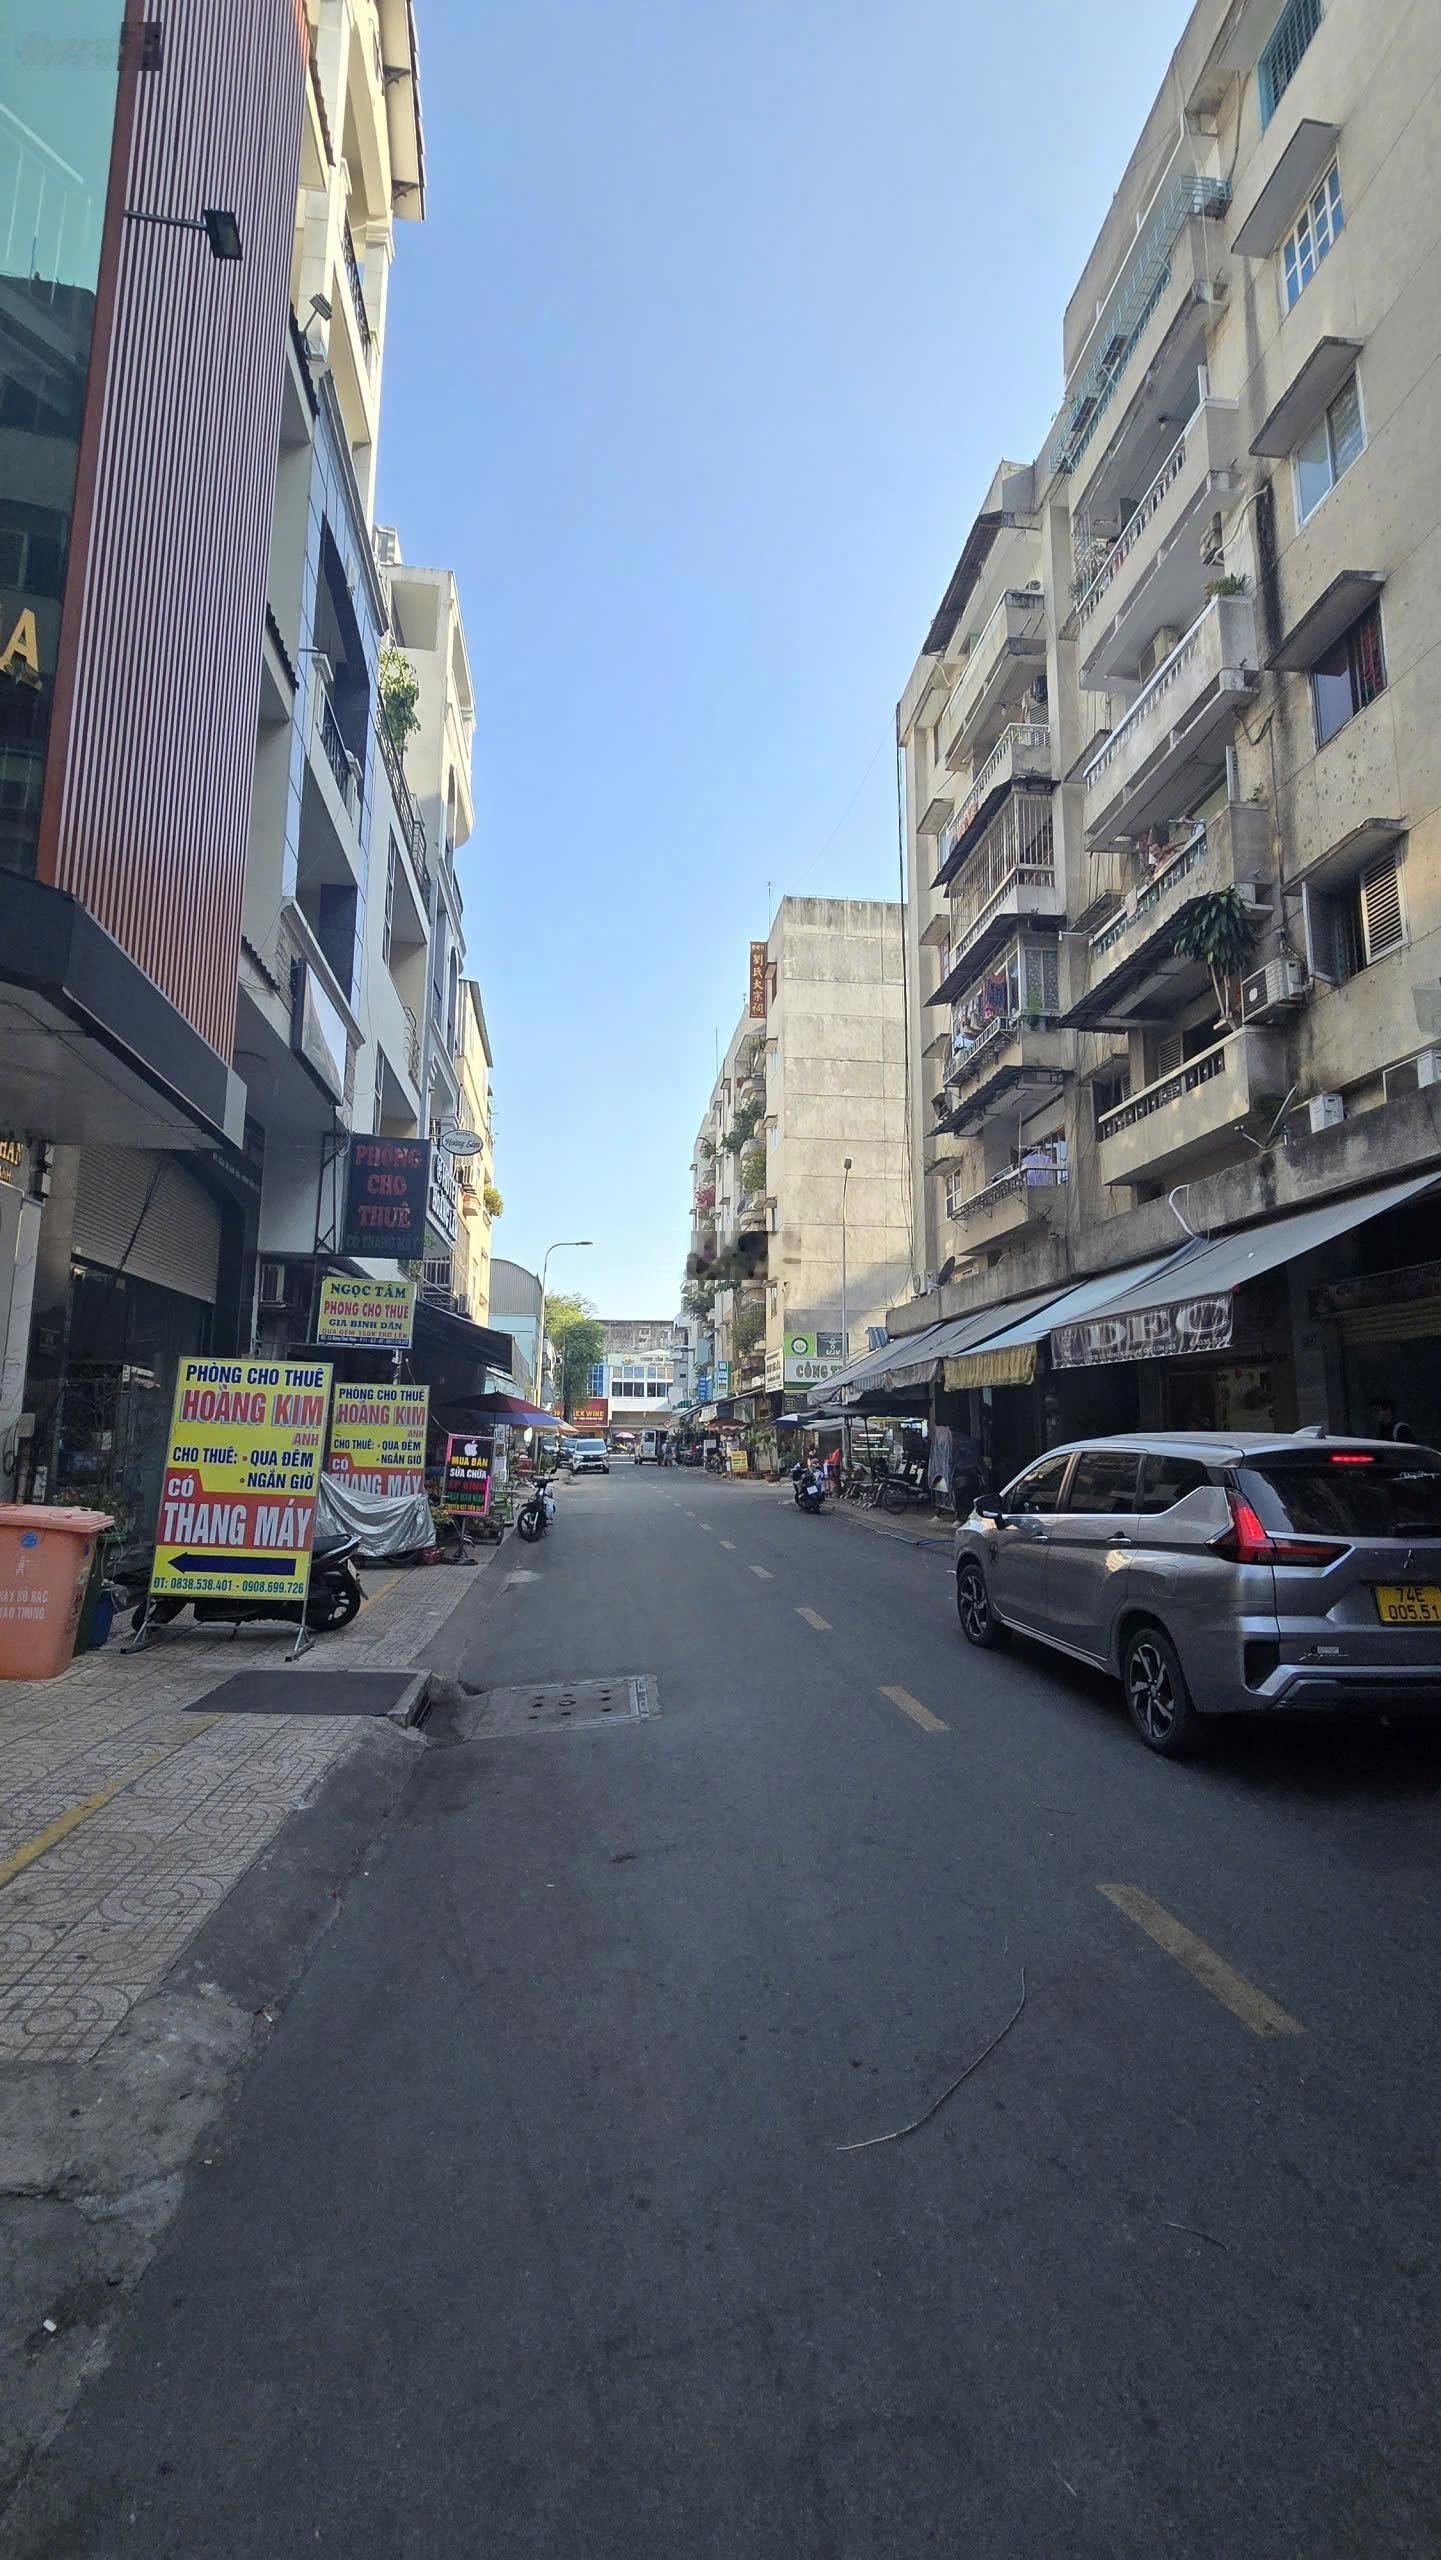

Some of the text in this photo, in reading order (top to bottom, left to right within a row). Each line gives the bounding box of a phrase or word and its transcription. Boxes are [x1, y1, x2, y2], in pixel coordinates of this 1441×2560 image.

[355, 1142, 422, 1168] PHÒNG
[367, 1174, 407, 1195] CHO
[358, 1201, 411, 1230] THUÊ
[331, 1283, 406, 1298] NGỌC TÂM
[362, 1303, 382, 1318] CHO
[385, 1303, 409, 1319] THUÊ
[186, 1362, 324, 1387] PHÒNG CHO THUÊ
[796, 1361, 828, 1378] CÔNG
[339, 1386, 425, 1401] PHÒNG CHO THUÊ
[180, 1384, 325, 1427] HOÀNG KIM
[336, 1400, 426, 1427] HOÀNG KIM
[293, 1432, 319, 1446] ANH
[408, 1430, 424, 1438] ANH
[334, 1440, 350, 1449] CHO
[382, 1440, 399, 1451] QUA
[402, 1440, 421, 1451] ĐÊM
[173, 1446, 314, 1467] CHO THUÊ: QUA ĐÊM
[332, 1456, 349, 1470] CÓ
[451, 1456, 470, 1466] MUA
[168, 1474, 195, 1498] CÓ
[247, 1469, 315, 1490] NGẮN GIỜ
[387, 1470, 422, 1497] MÁY
[163, 1498, 312, 1548] THANG MÁY
[170, 1578, 232, 1591] 0838.538.401
[242, 1580, 304, 1594] 0908.699.726
[1395, 1587, 1426, 1603] 74E
[1388, 1604, 1440, 1620] 005.51
